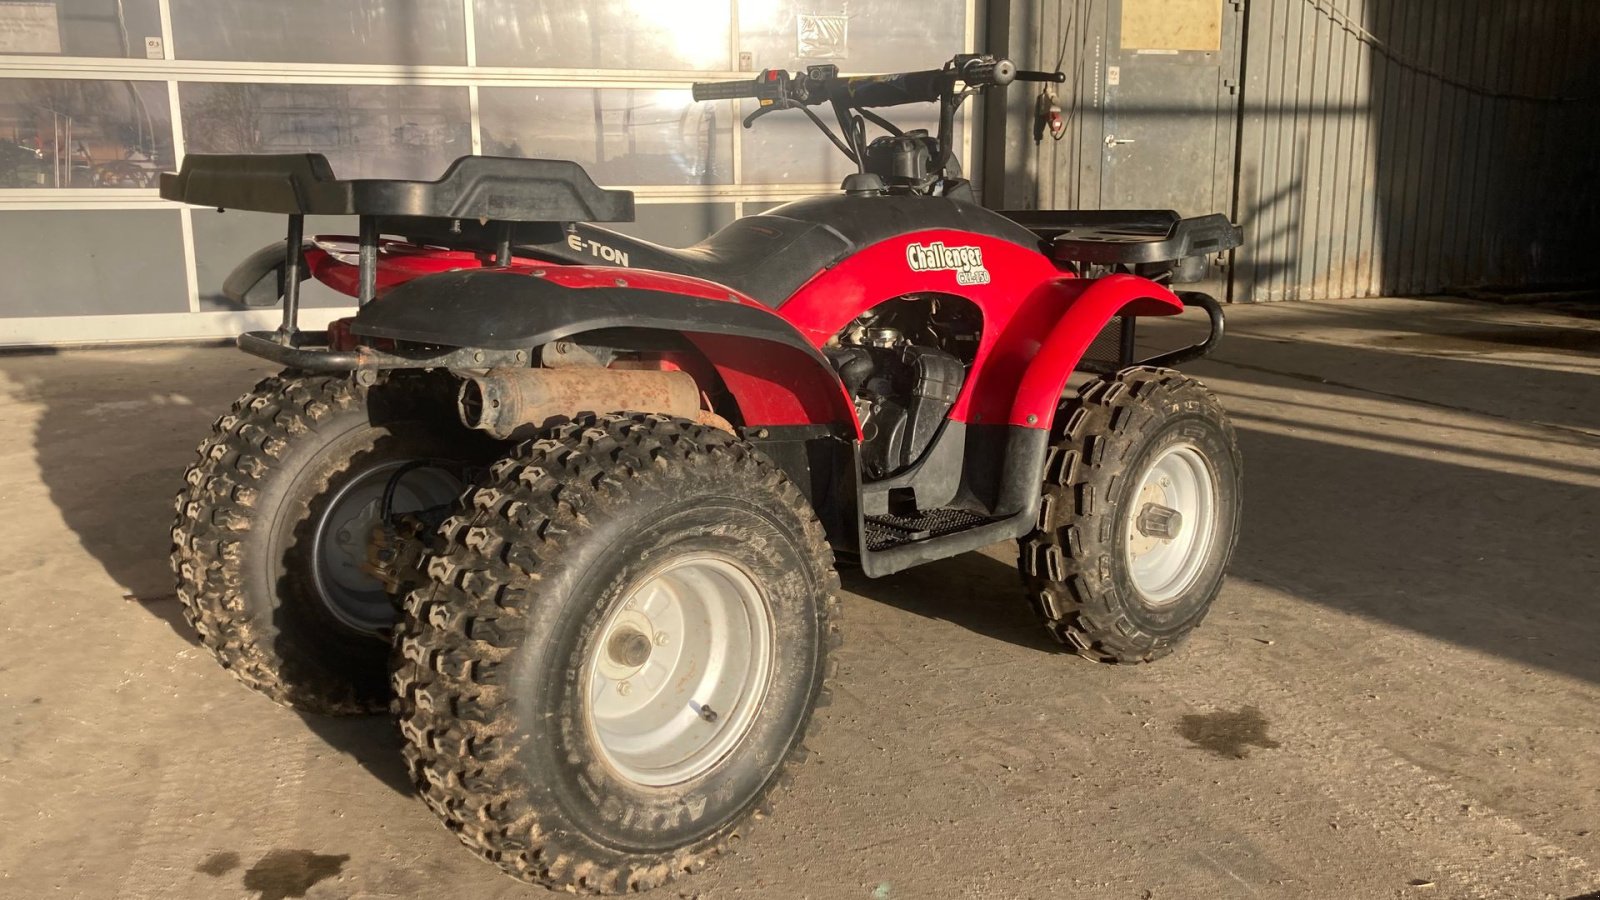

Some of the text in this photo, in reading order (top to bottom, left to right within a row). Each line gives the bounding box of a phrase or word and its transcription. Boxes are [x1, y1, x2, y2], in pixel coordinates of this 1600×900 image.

[567, 234, 629, 268] E-TON
[907, 243, 982, 272] Challenger
[957, 270, 990, 284] CXL-150
